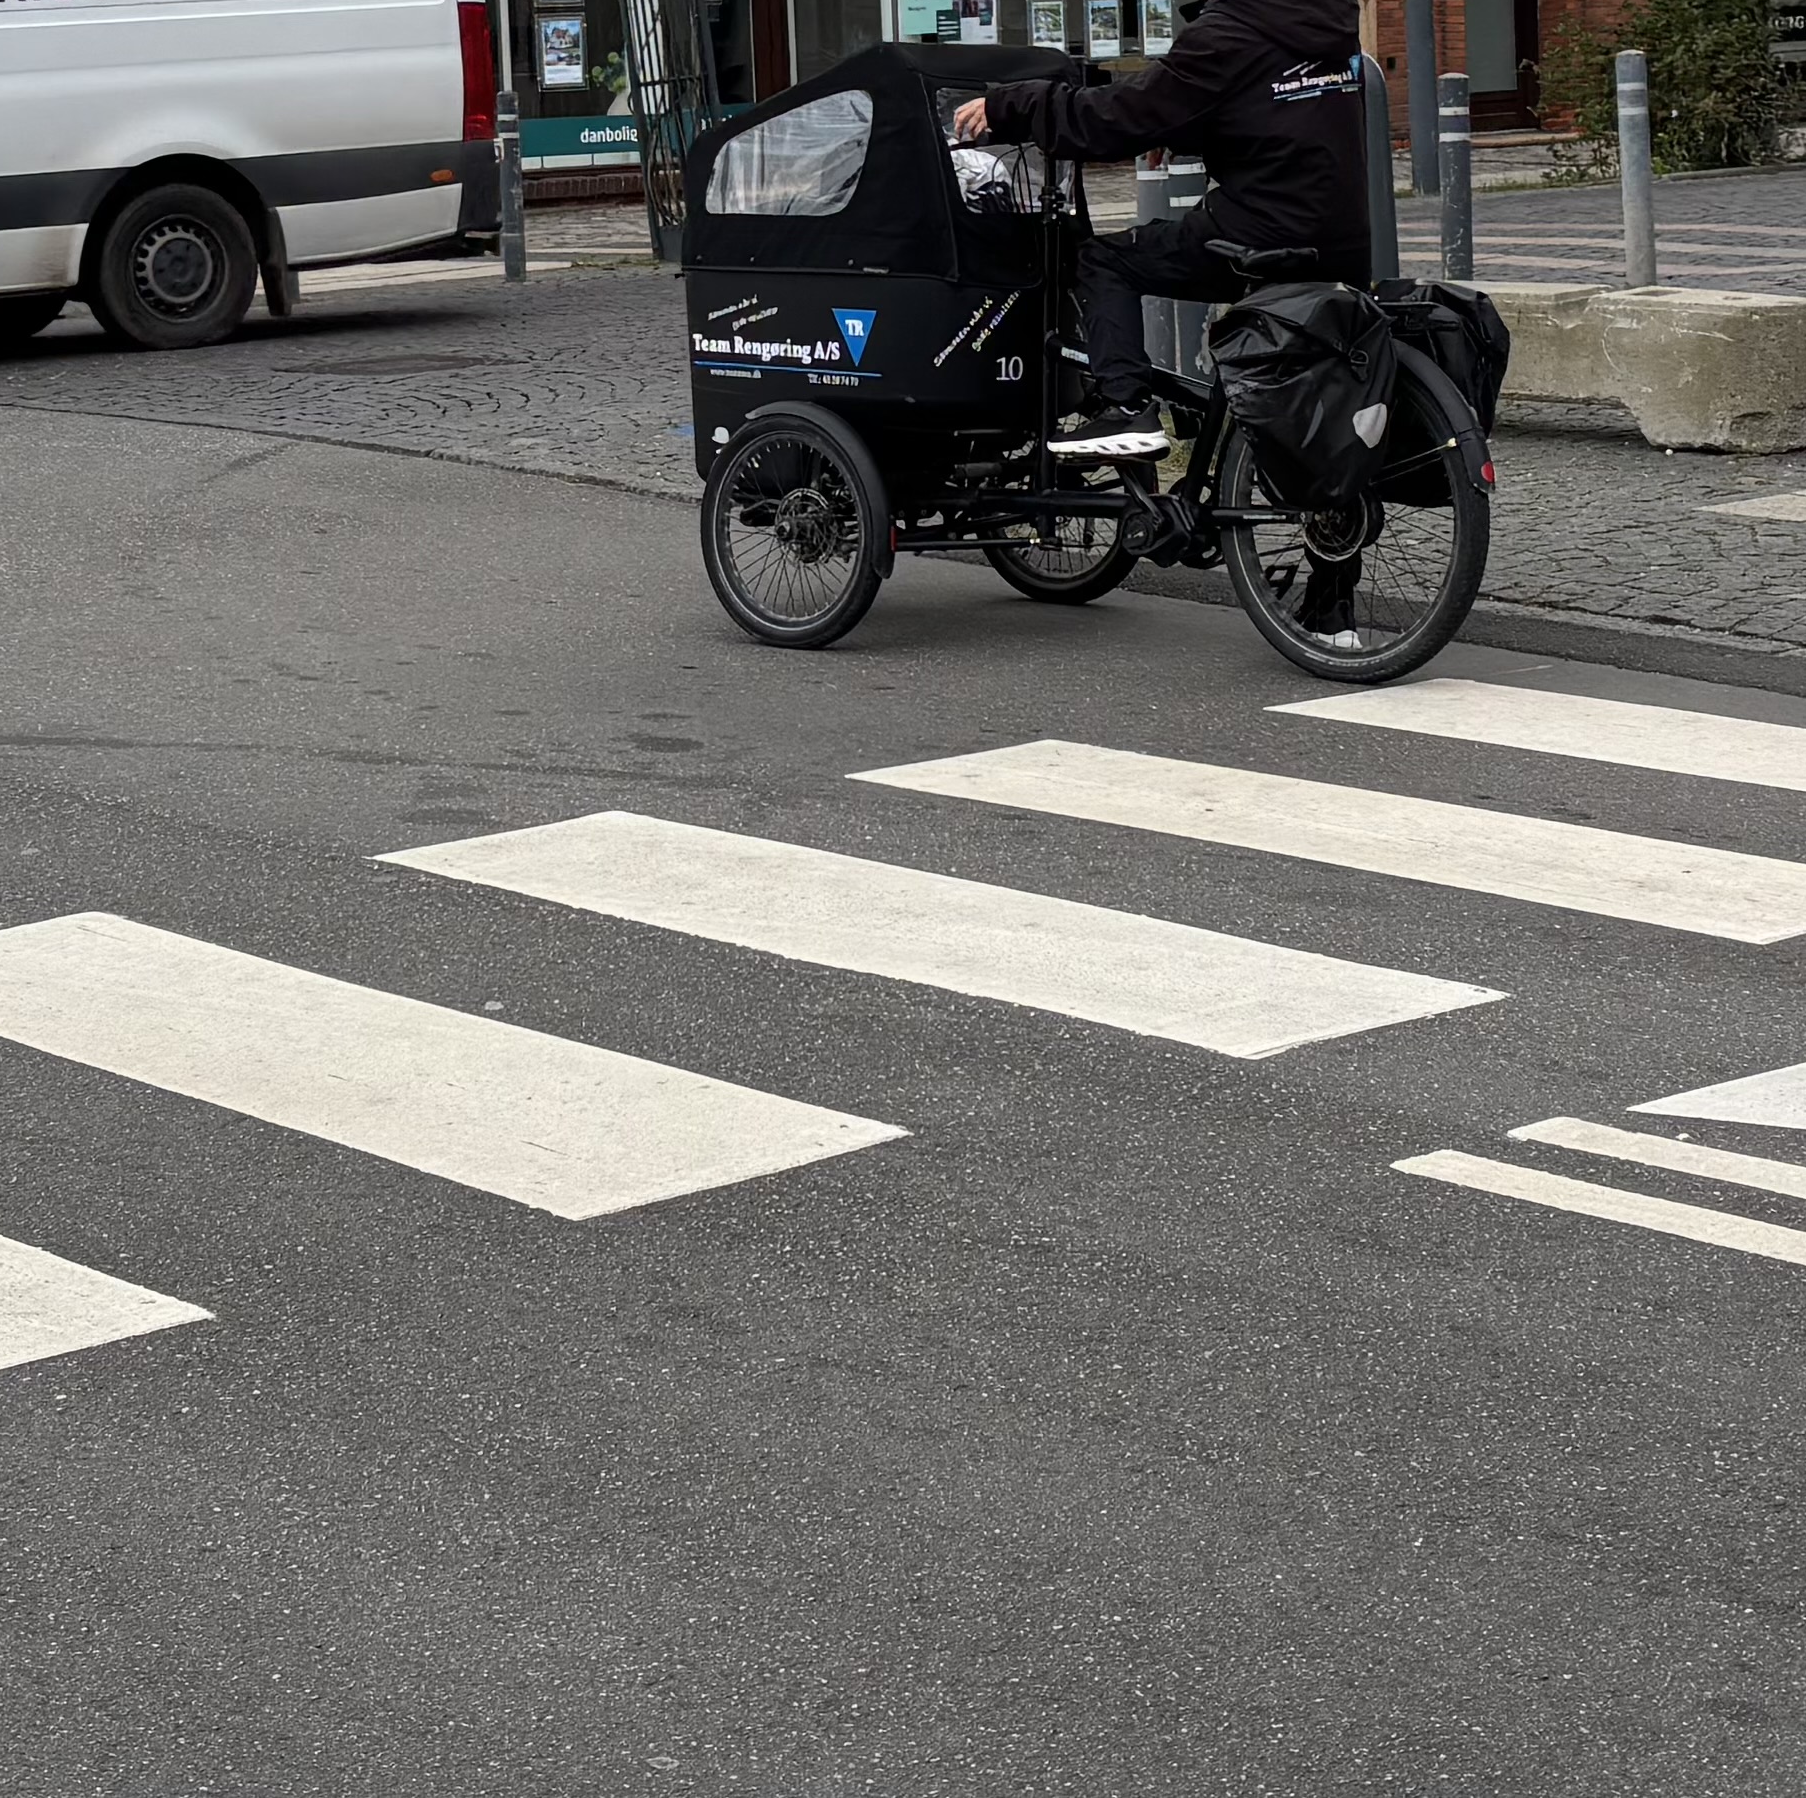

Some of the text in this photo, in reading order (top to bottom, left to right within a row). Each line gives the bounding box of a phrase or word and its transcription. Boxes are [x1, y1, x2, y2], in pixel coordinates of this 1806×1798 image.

[580, 126, 638, 144] danbolig
[845, 319, 865, 337] TR
[692, 333, 841, 364] Team Rengøring A/S
[996, 355, 1024, 381] 10
